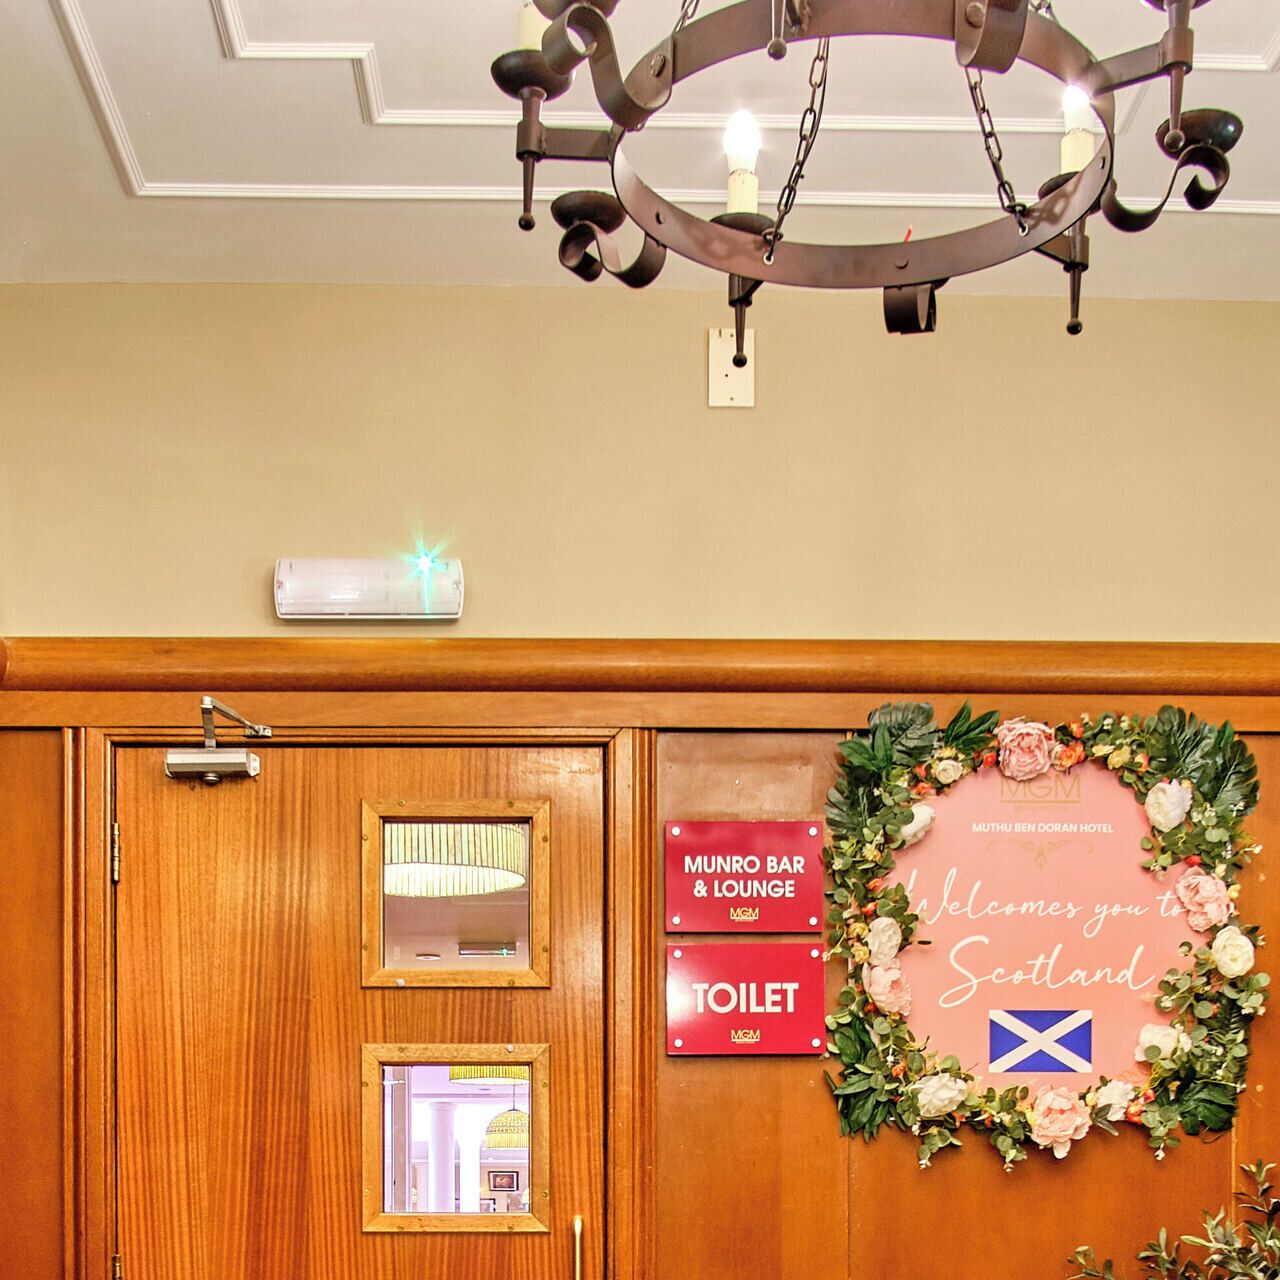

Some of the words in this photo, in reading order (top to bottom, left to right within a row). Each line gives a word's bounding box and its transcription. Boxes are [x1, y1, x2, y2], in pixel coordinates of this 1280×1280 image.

[1000, 774, 1081, 799] MGM
[972, 823, 1012, 833] MUTHU
[1014, 823, 1036, 833] BEN
[1038, 823, 1077, 833] DORAN
[1079, 823, 1114, 833] HOTEL
[684, 855, 761, 874] MUNRO
[766, 855, 805, 874] BAR
[693, 879, 708, 898] &
[713, 879, 796, 898] LOUNGE
[904, 866, 1083, 925] Welcomes
[1082, 900, 1150, 939] you
[1155, 890, 1188, 919] to
[729, 907, 760, 919] MGM
[938, 935, 1156, 1008] Scotland
[691, 982, 800, 1014] TOILET
[731, 1029, 761, 1041] MGM
